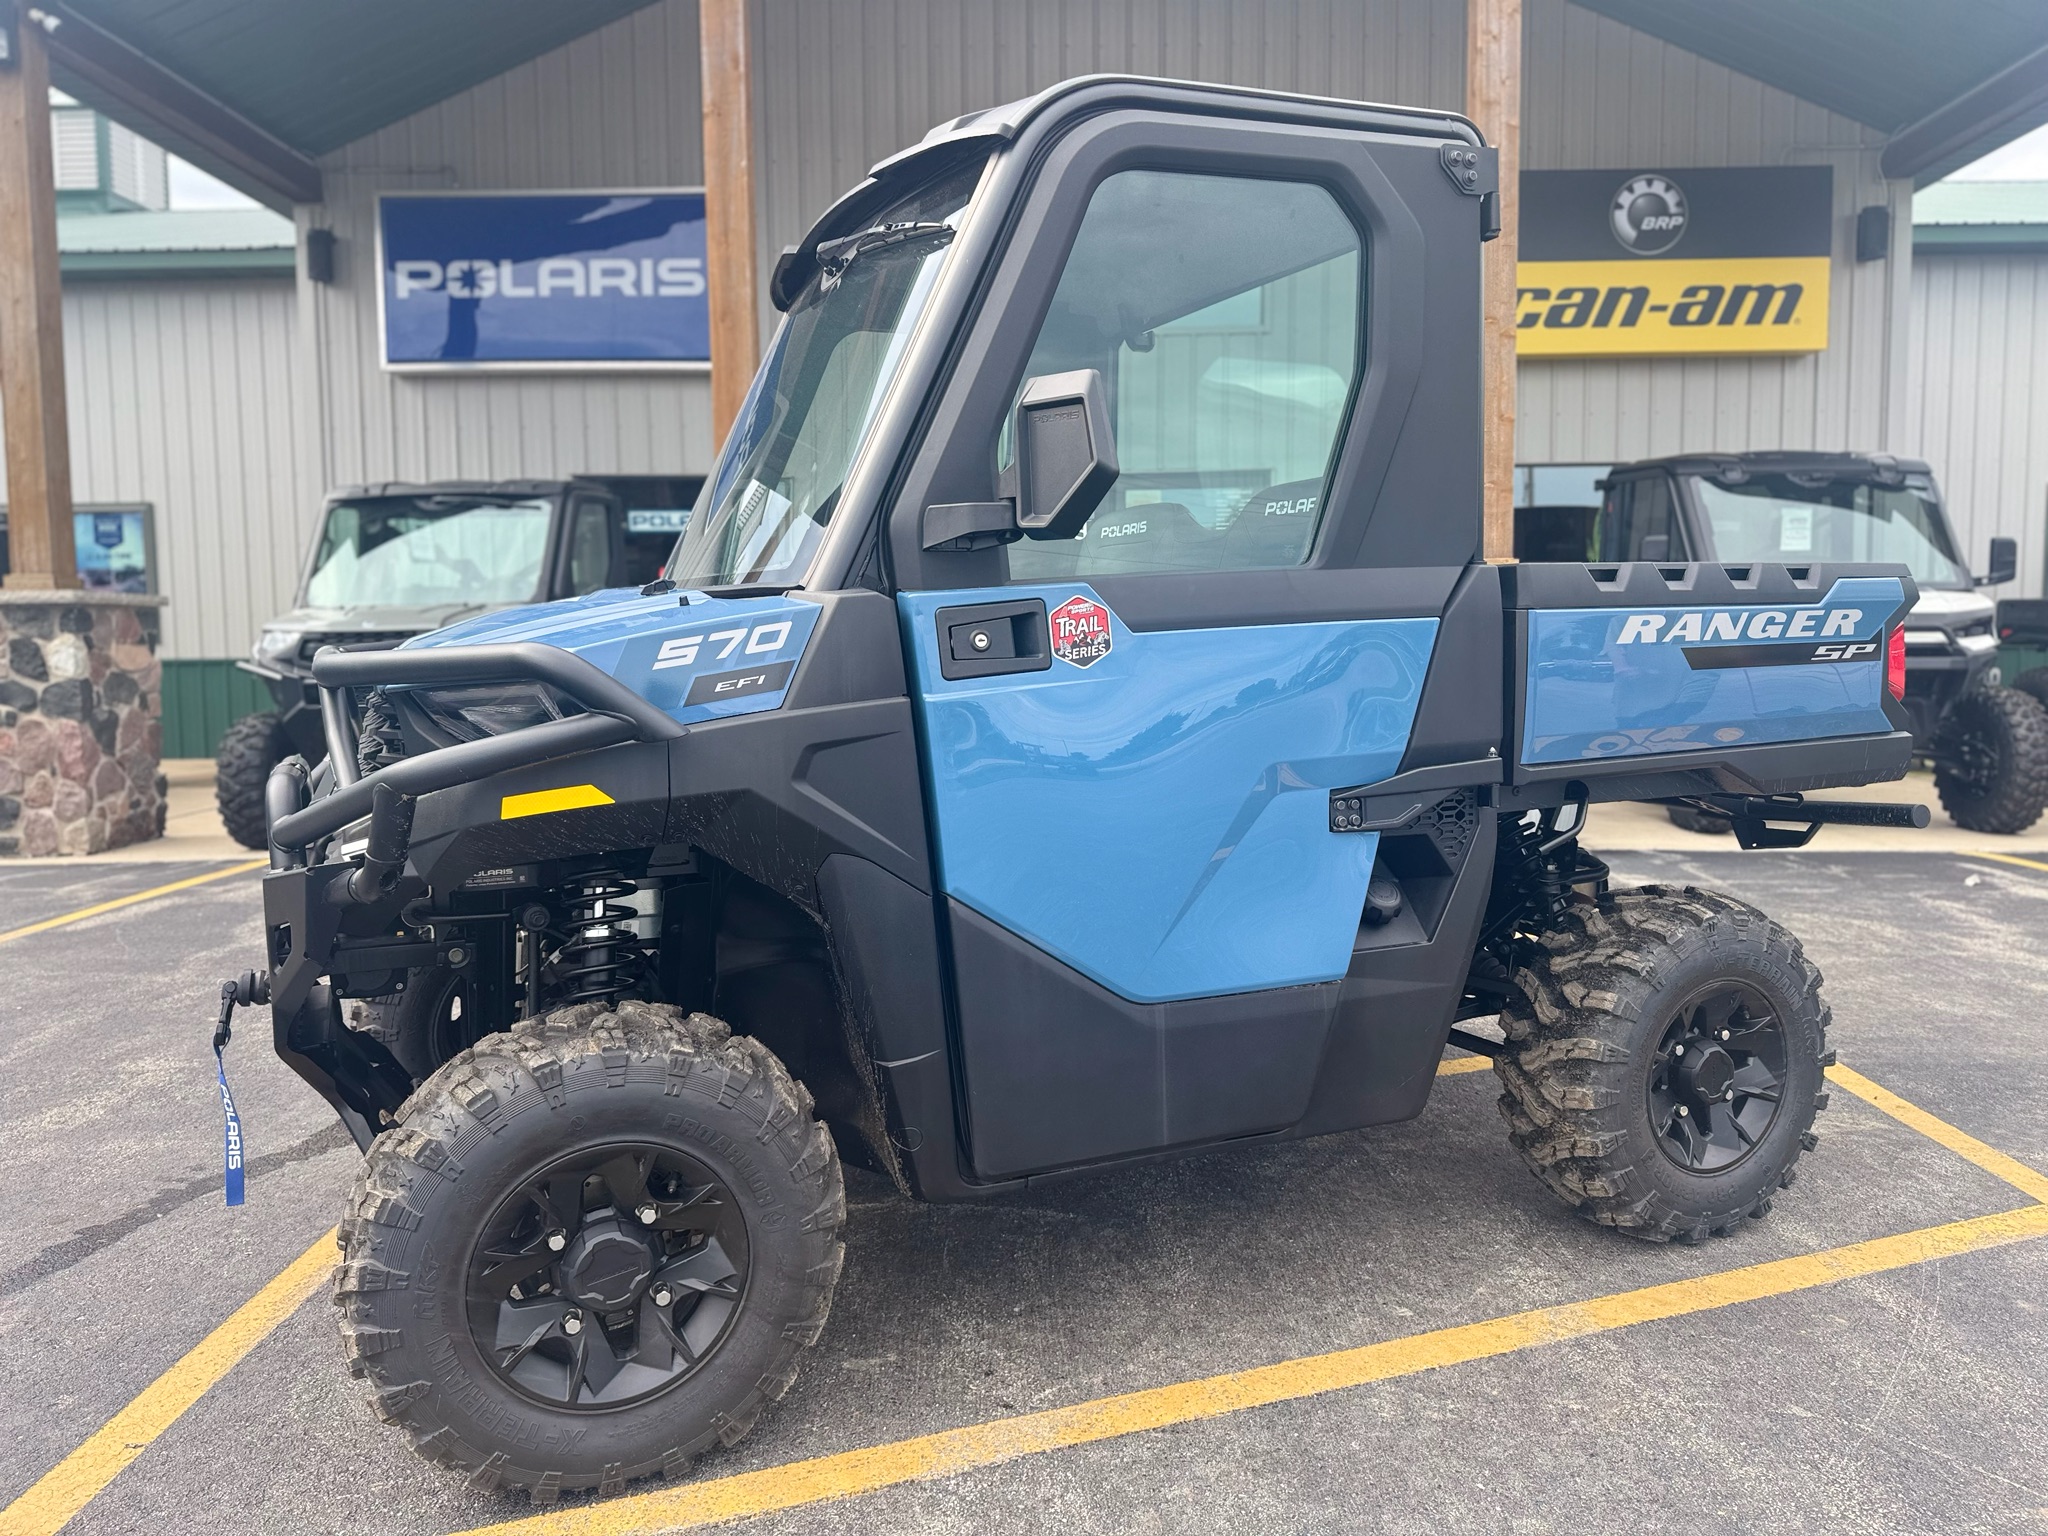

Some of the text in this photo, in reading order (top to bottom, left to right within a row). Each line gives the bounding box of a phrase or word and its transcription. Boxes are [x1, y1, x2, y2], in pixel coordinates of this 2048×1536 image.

[1640, 215, 1685, 231] BRP
[394, 257, 706, 299] POLARIS
[1516, 282, 1804, 329] can-am
[1032, 409, 1080, 424] POLARIS
[1100, 520, 1147, 539] POLARIS
[1055, 615, 1104, 638] TRAIL
[1616, 608, 1863, 645] RANGER
[652, 620, 793, 671] 570
[1064, 643, 1106, 661] SERIES
[1810, 643, 1878, 661] SP
[714, 674, 766, 693] EFI
[1710, 950, 1804, 1012] X-TERRAIN
[220, 1084, 241, 1170] POLARIS
[424, 1332, 588, 1457] X-TERRAIN
